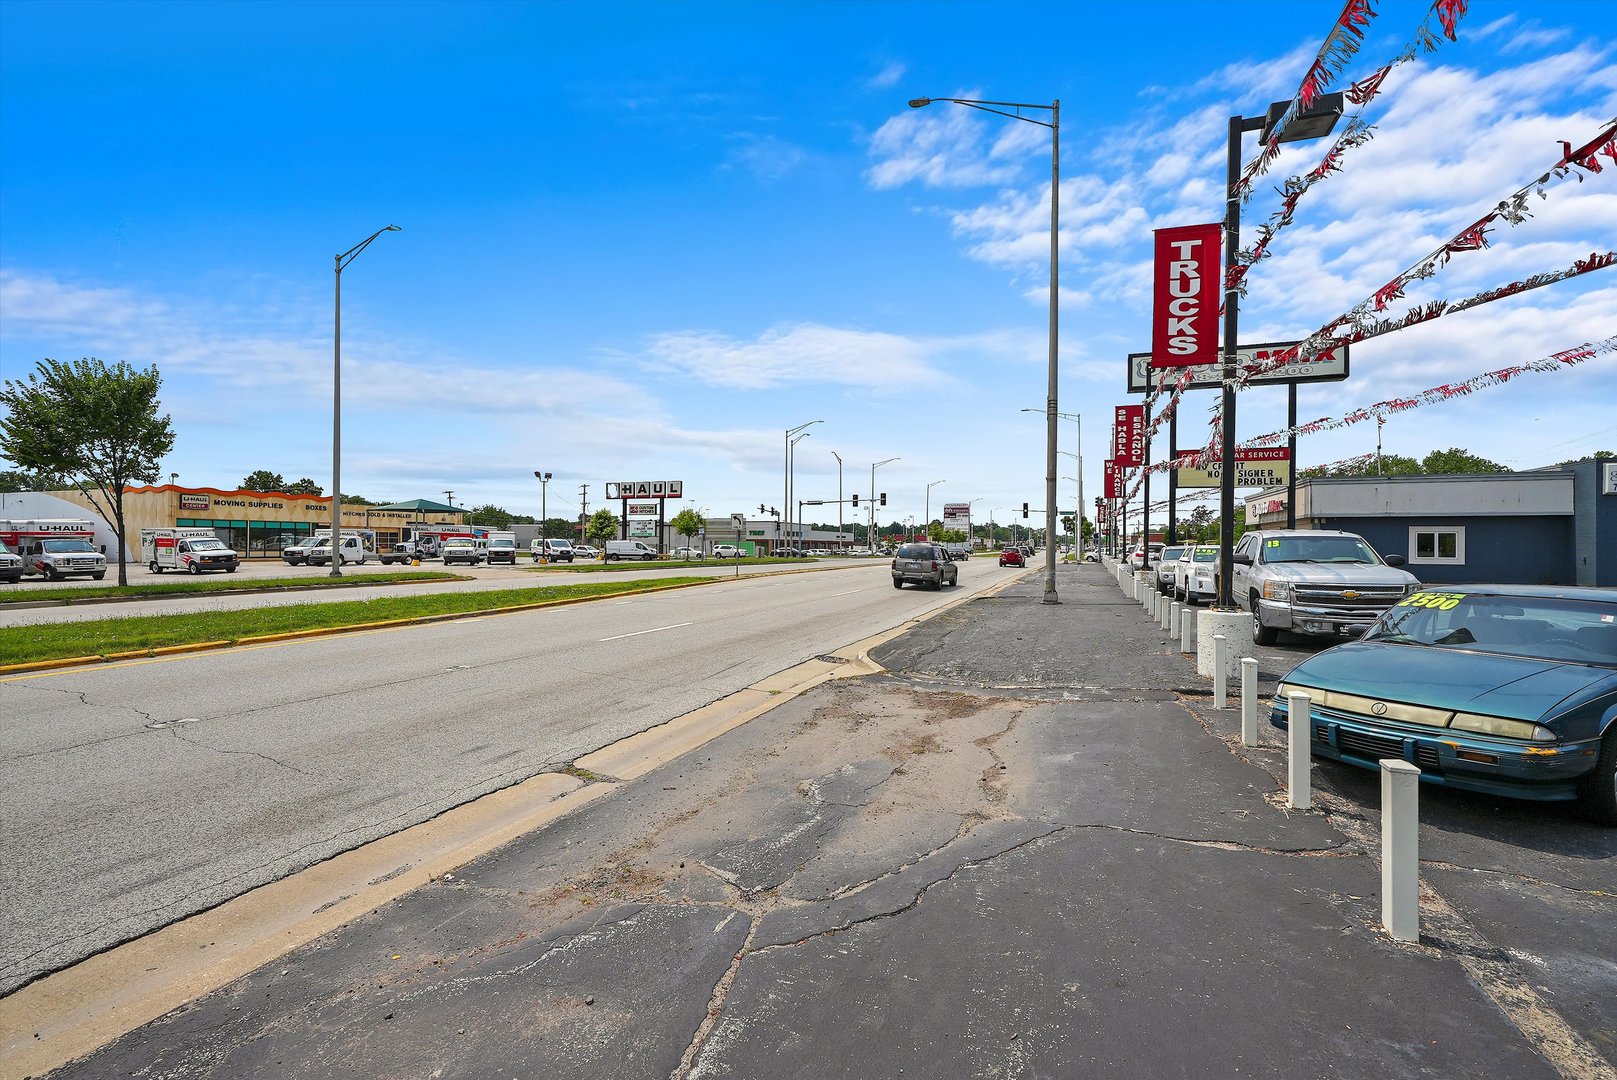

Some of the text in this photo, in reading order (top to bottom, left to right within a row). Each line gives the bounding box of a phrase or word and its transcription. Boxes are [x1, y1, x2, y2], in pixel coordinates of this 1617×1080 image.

[1168, 239, 1202, 355] TRUCKS
[1117, 409, 1127, 455] SE HABLA
[1106, 462, 1114, 474] WE
[1238, 470, 1274, 478] SIGNER
[1237, 478, 1283, 486] PROBLEM
[248, 501, 283, 509] SUPPLIES
